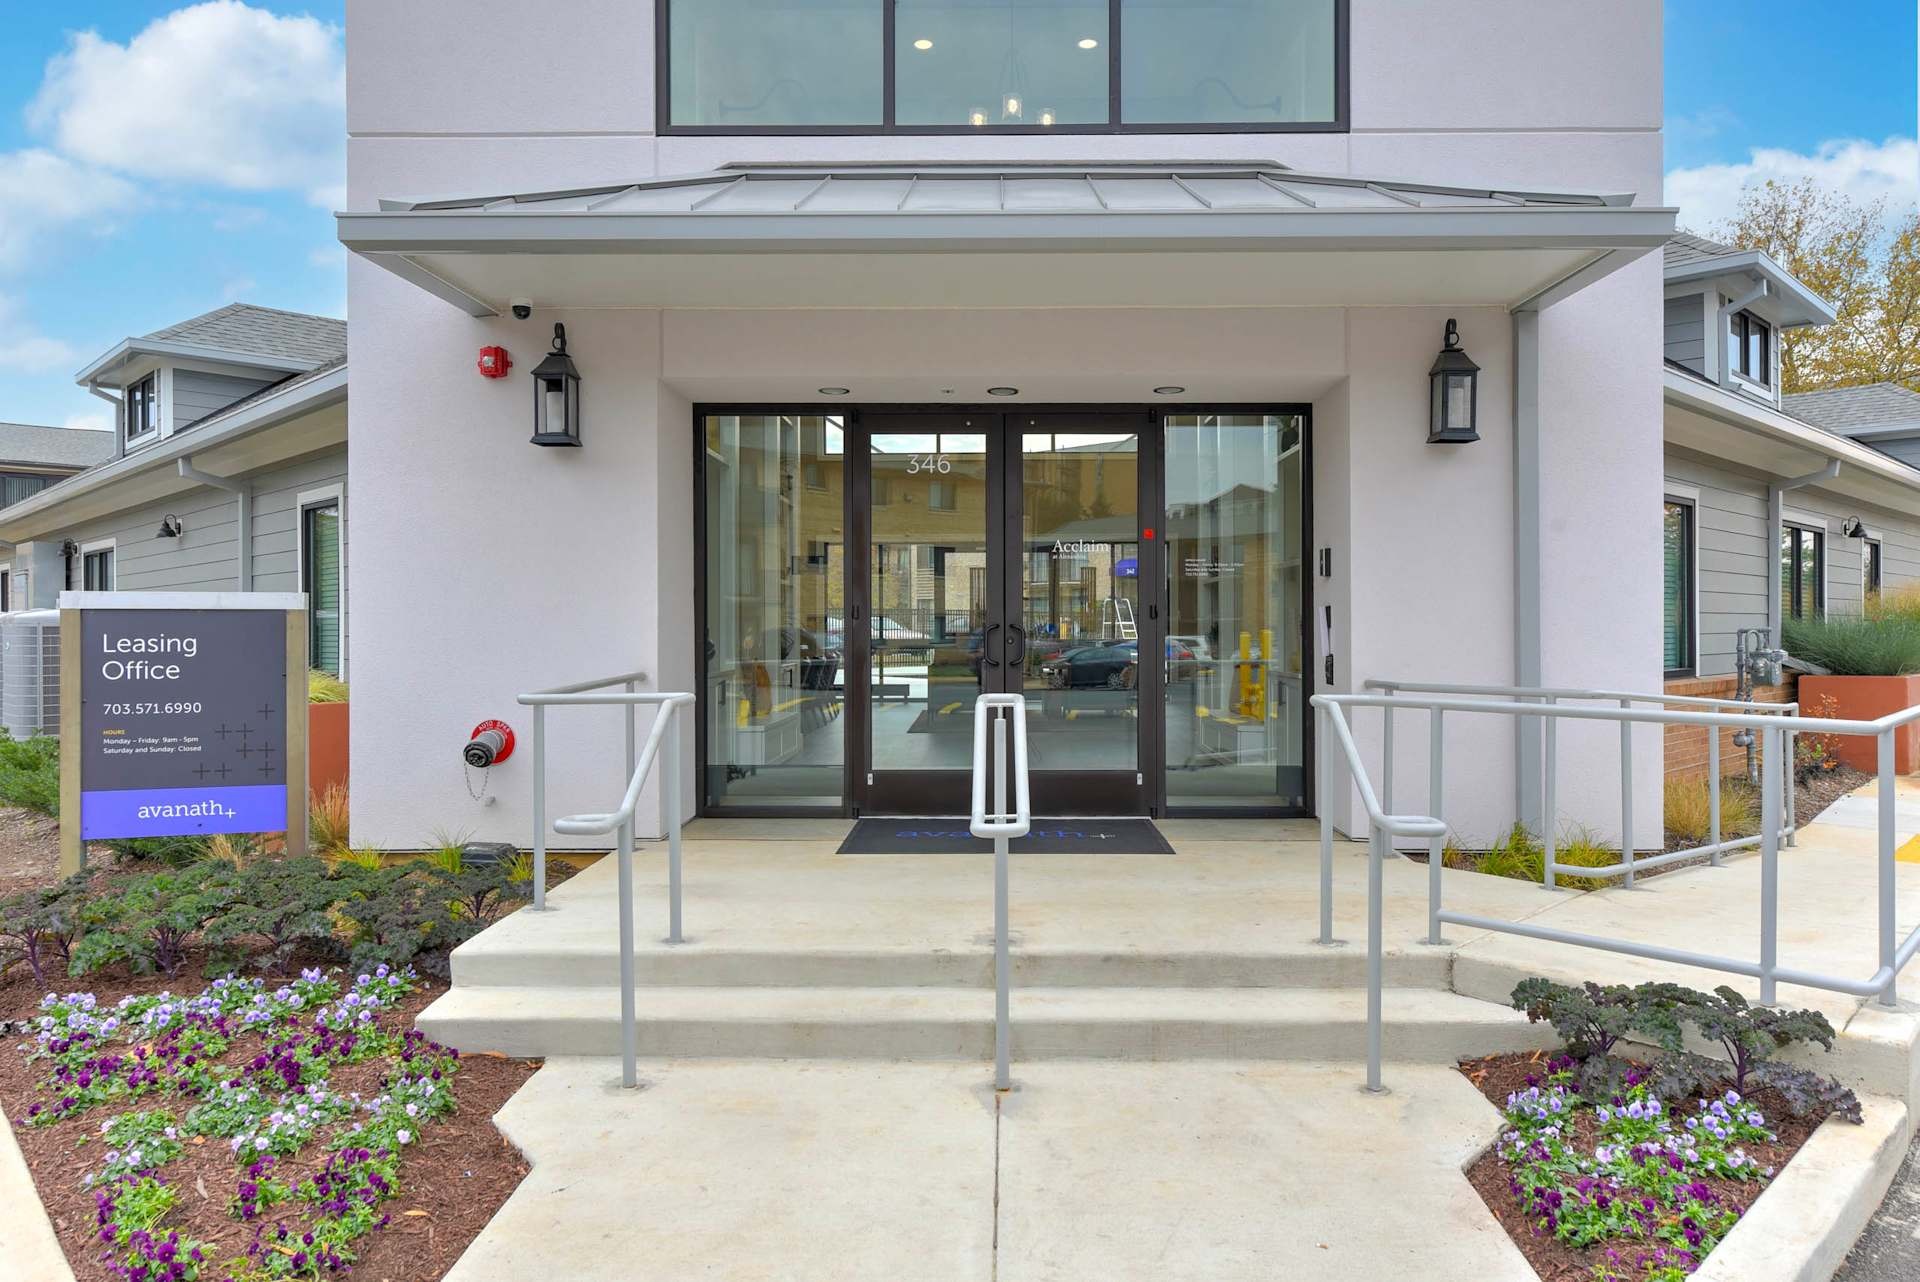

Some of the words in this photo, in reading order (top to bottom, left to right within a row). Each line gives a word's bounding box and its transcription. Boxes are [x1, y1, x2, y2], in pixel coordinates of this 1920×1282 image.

[906, 454, 951, 474] 346
[1052, 539, 1110, 553] Acclaim
[103, 633, 197, 657] Leasing
[102, 660, 181, 680] Office
[103, 702, 202, 715] 703.571.6990
[183, 736, 199, 744] 5pm
